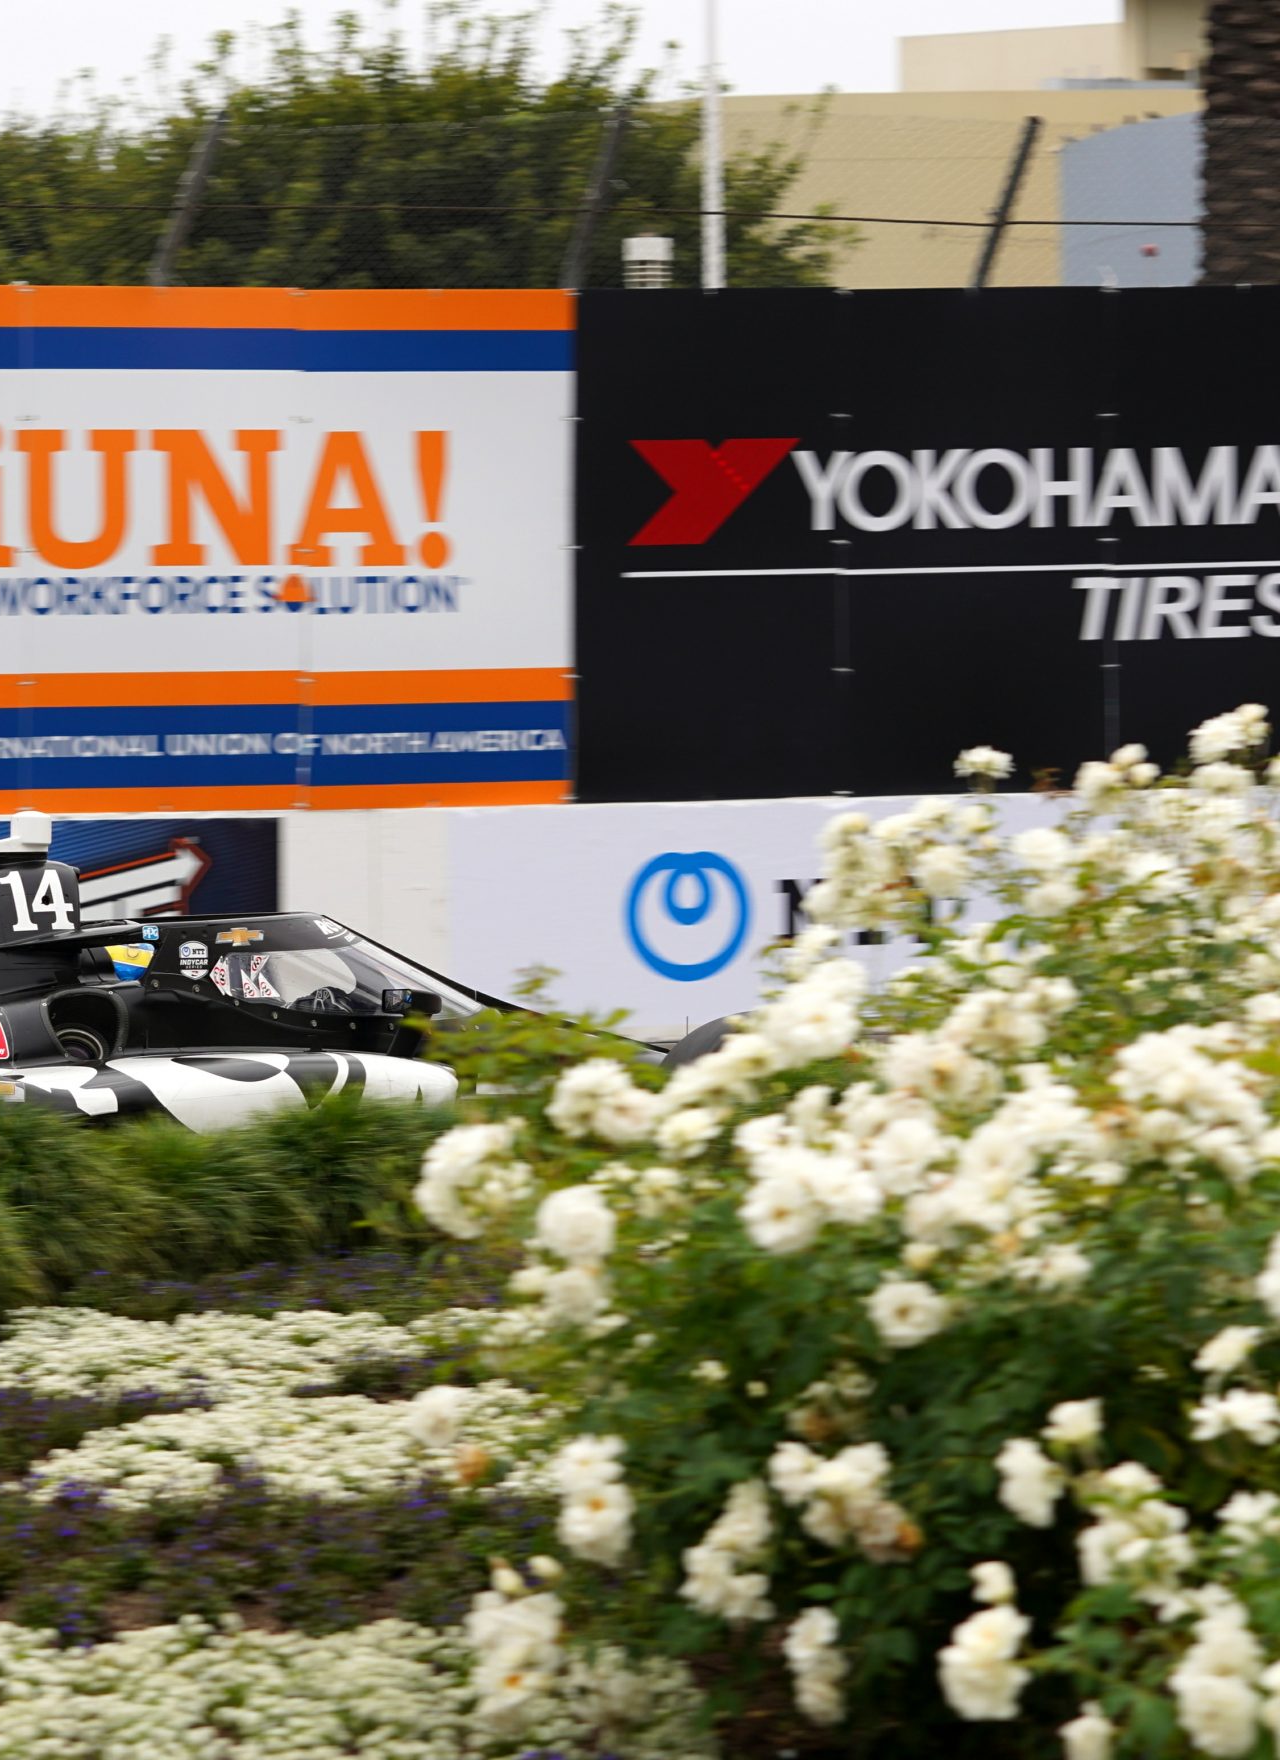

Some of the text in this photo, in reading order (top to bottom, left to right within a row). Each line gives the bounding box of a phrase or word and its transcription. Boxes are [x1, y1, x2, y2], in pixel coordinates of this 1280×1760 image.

[790, 444, 1280, 531] YOKOHAMA
[165, 732, 272, 757] UNION
[273, 732, 319, 756] OF
[320, 731, 434, 755] NORTH
[431, 729, 568, 752] AMERICA
